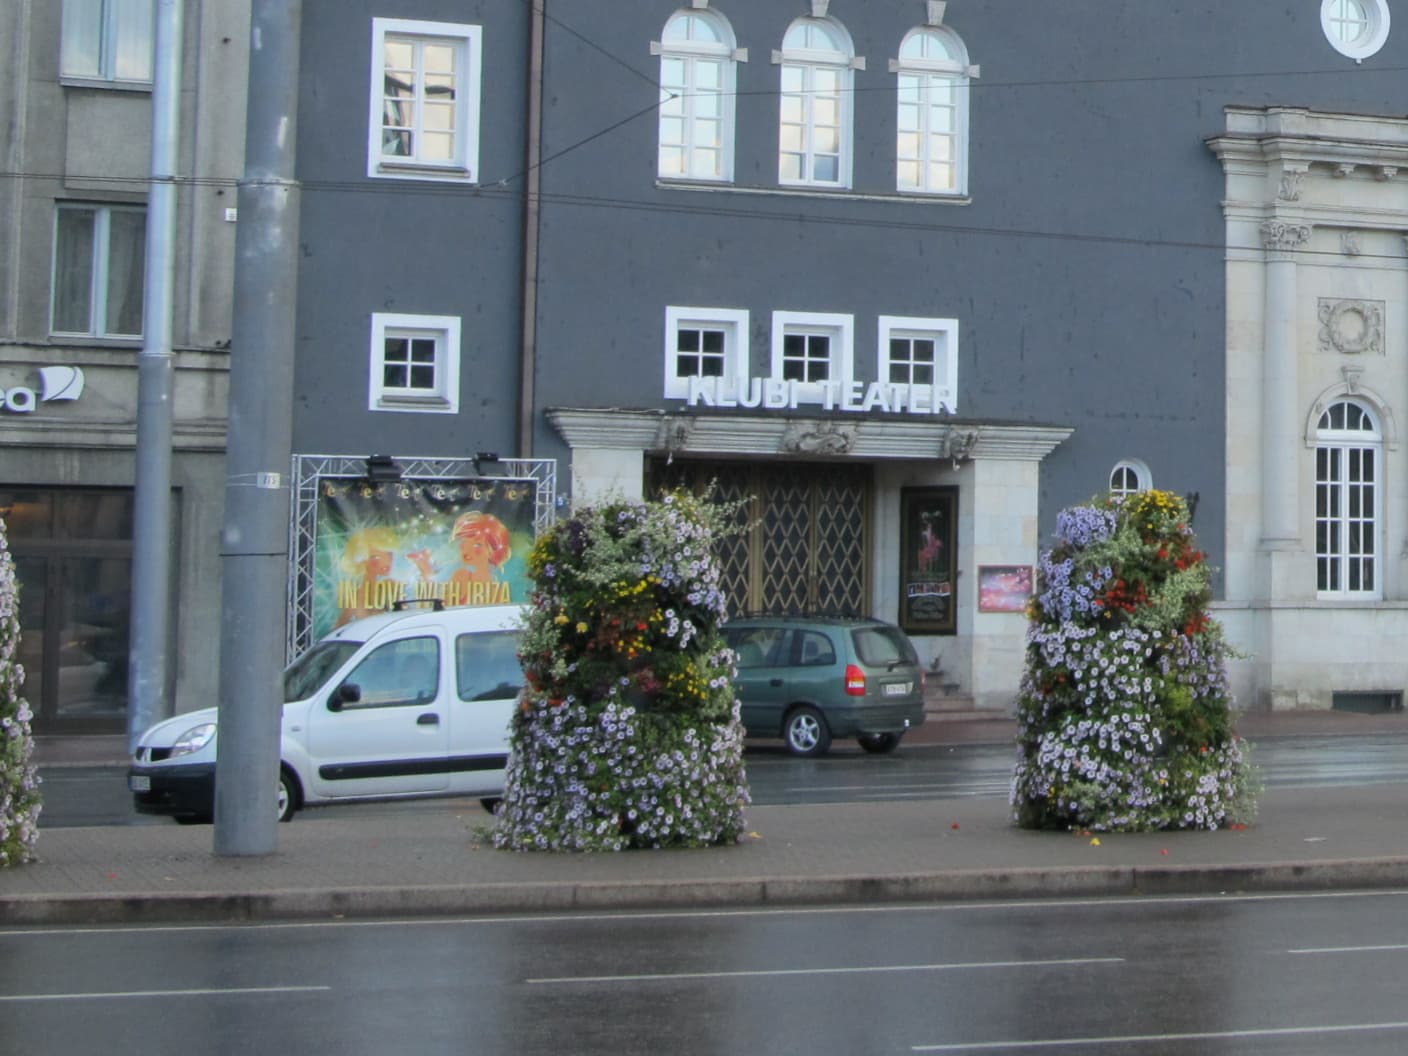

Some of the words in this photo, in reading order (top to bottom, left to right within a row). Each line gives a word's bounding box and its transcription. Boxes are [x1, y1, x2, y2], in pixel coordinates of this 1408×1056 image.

[0, 387, 36, 413] a
[688, 376, 800, 409] KLUBI
[815, 379, 957, 414] TEATER
[338, 581, 357, 609] IN
[364, 580, 408, 609] LOVE
[415, 580, 460, 607] WITH
[466, 580, 512, 606] IBIZA
